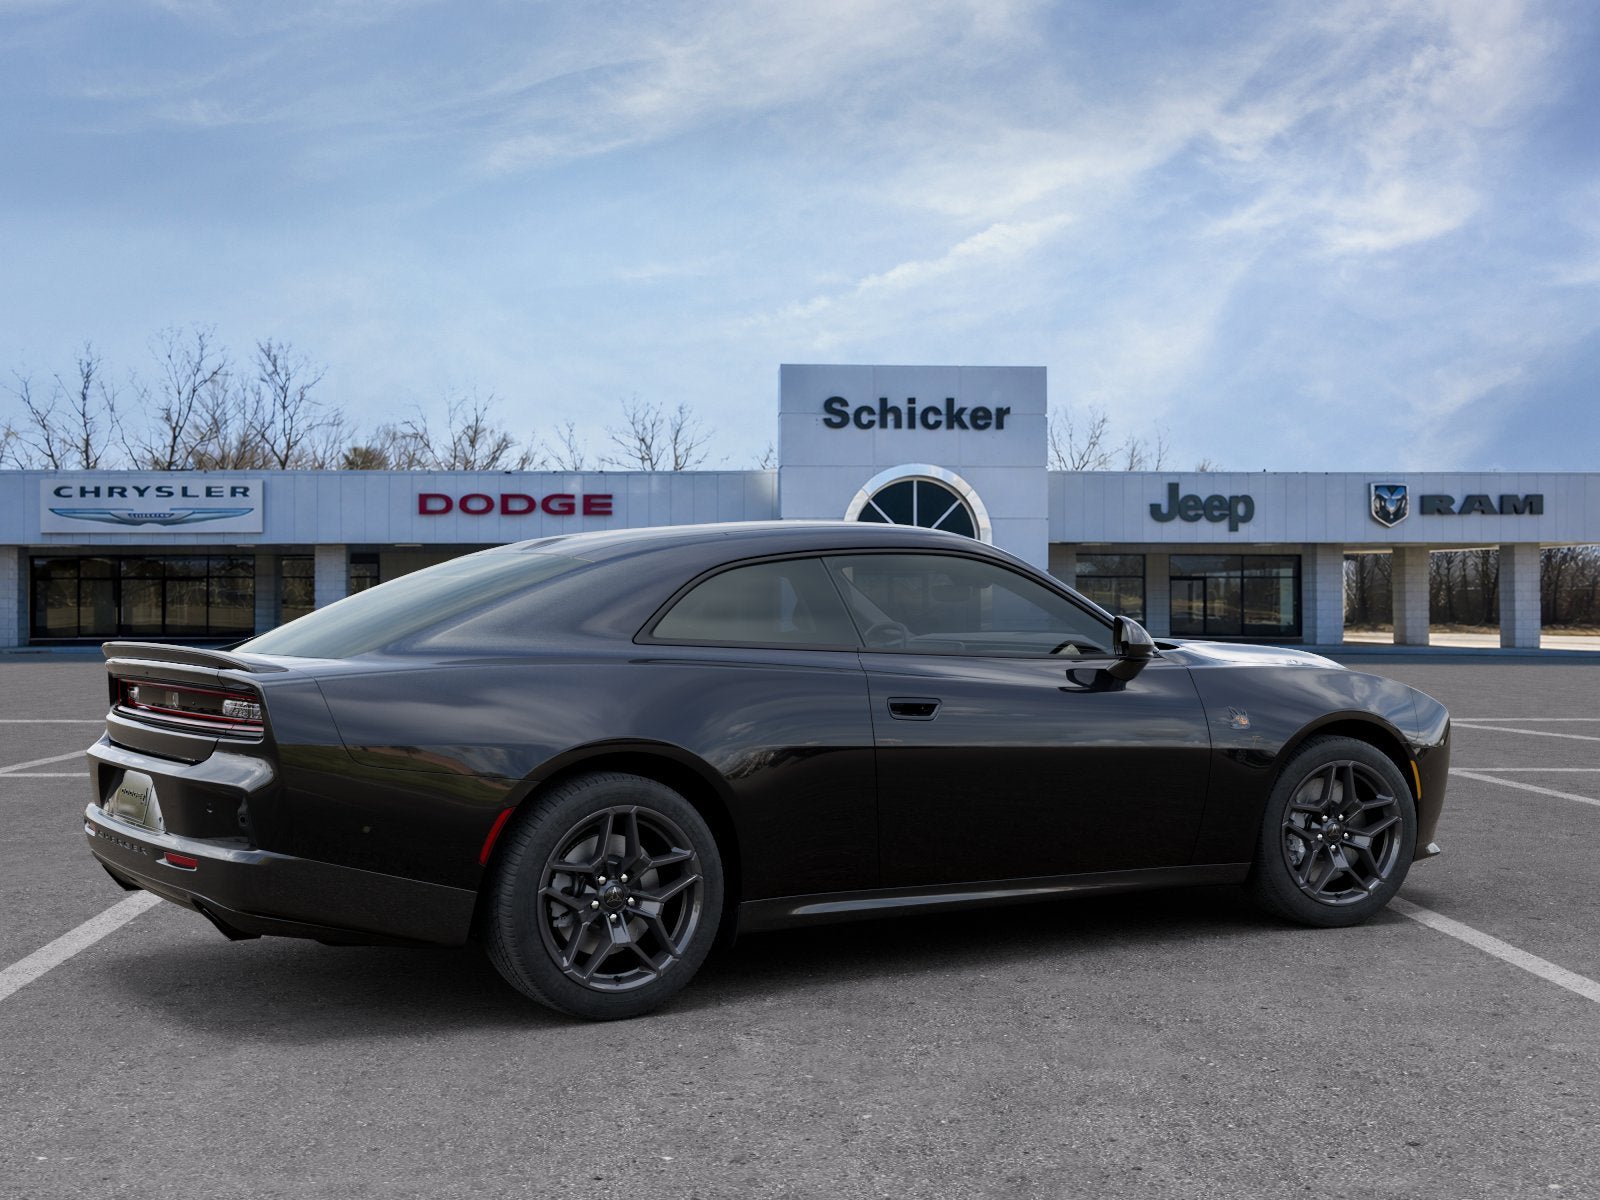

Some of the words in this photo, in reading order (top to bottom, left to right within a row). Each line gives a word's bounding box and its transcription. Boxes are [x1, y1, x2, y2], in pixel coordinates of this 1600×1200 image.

[823, 396, 1011, 430] Schicker
[53, 486, 250, 498] CHRYSLER
[418, 493, 613, 515] DODGE
[1149, 482, 1255, 532] Jeep
[1420, 494, 1543, 515] RAM
